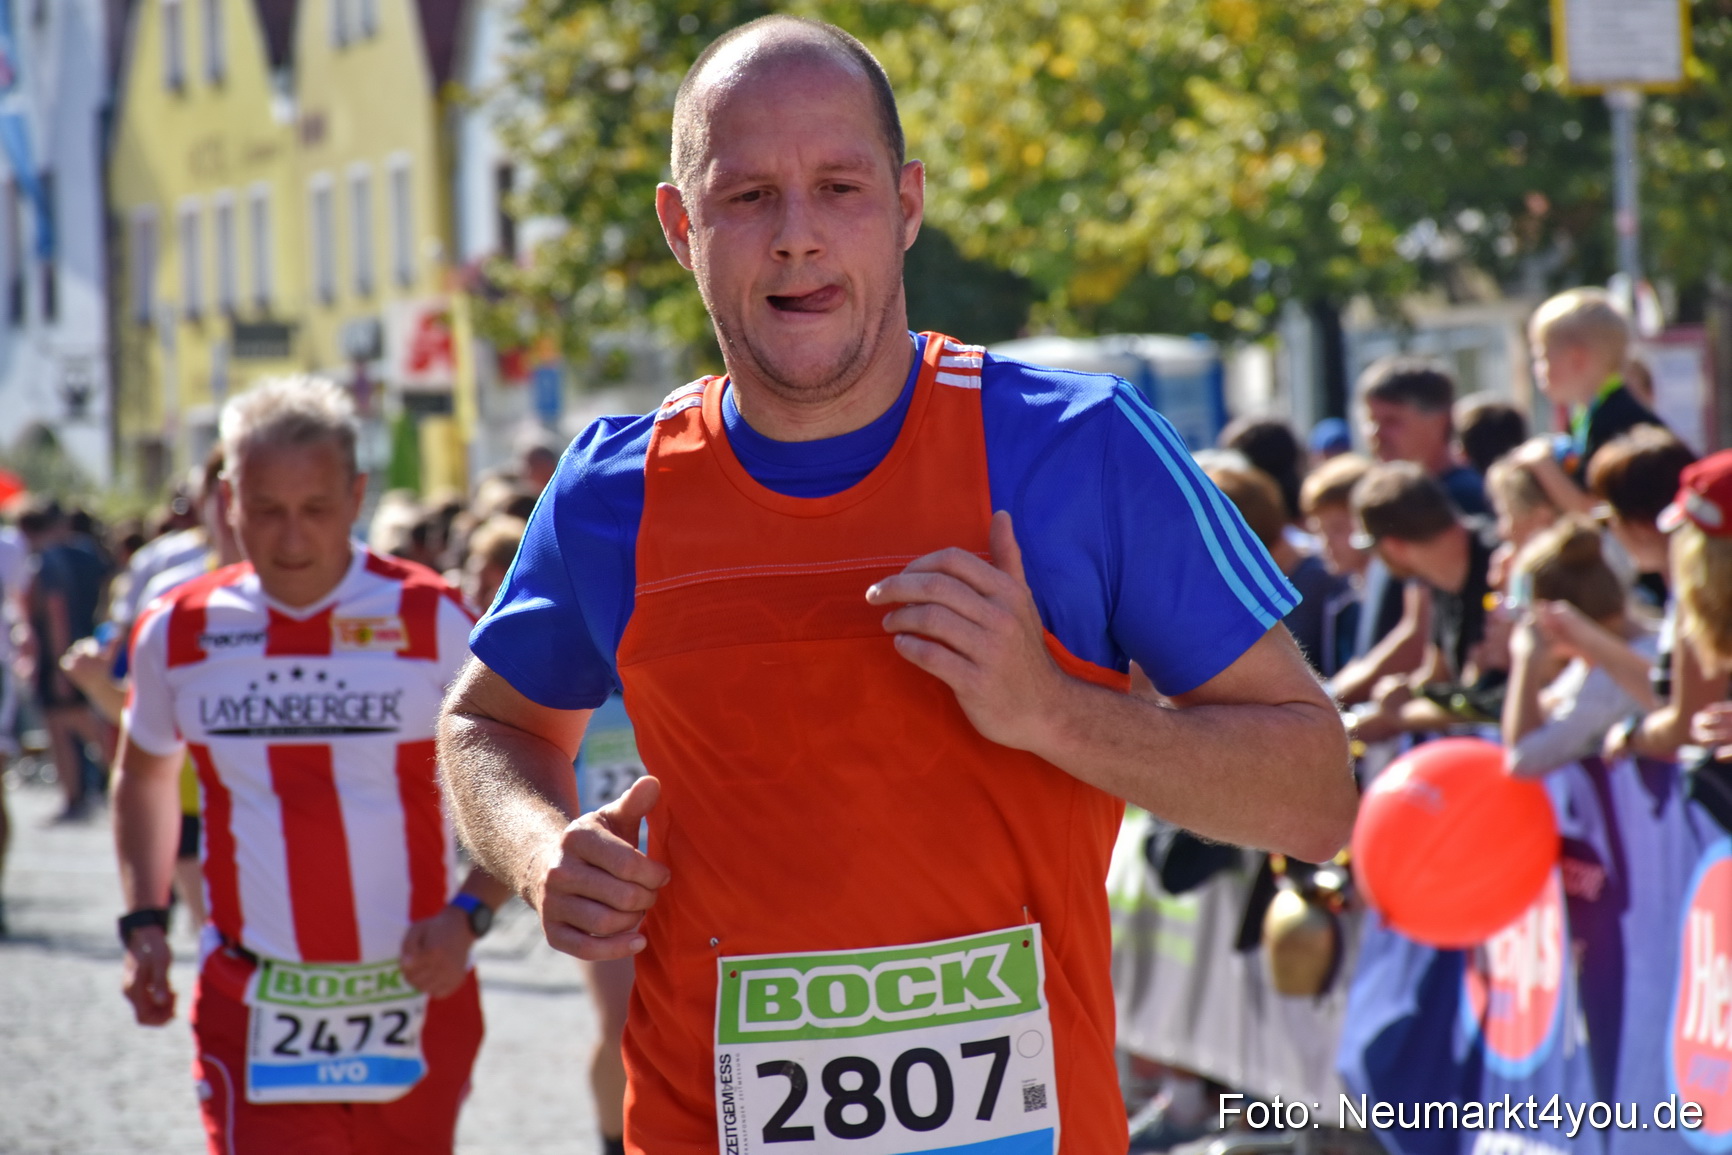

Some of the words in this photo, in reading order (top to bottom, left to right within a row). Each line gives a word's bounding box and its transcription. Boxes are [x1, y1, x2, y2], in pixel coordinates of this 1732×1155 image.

[200, 692, 400, 727] LAYENBERGER
[272, 968, 402, 998] BOCK
[743, 949, 1013, 1026] BOCK
[272, 1009, 410, 1057] 2472
[318, 1060, 368, 1083] IVO
[756, 1035, 1011, 1144] 2807
